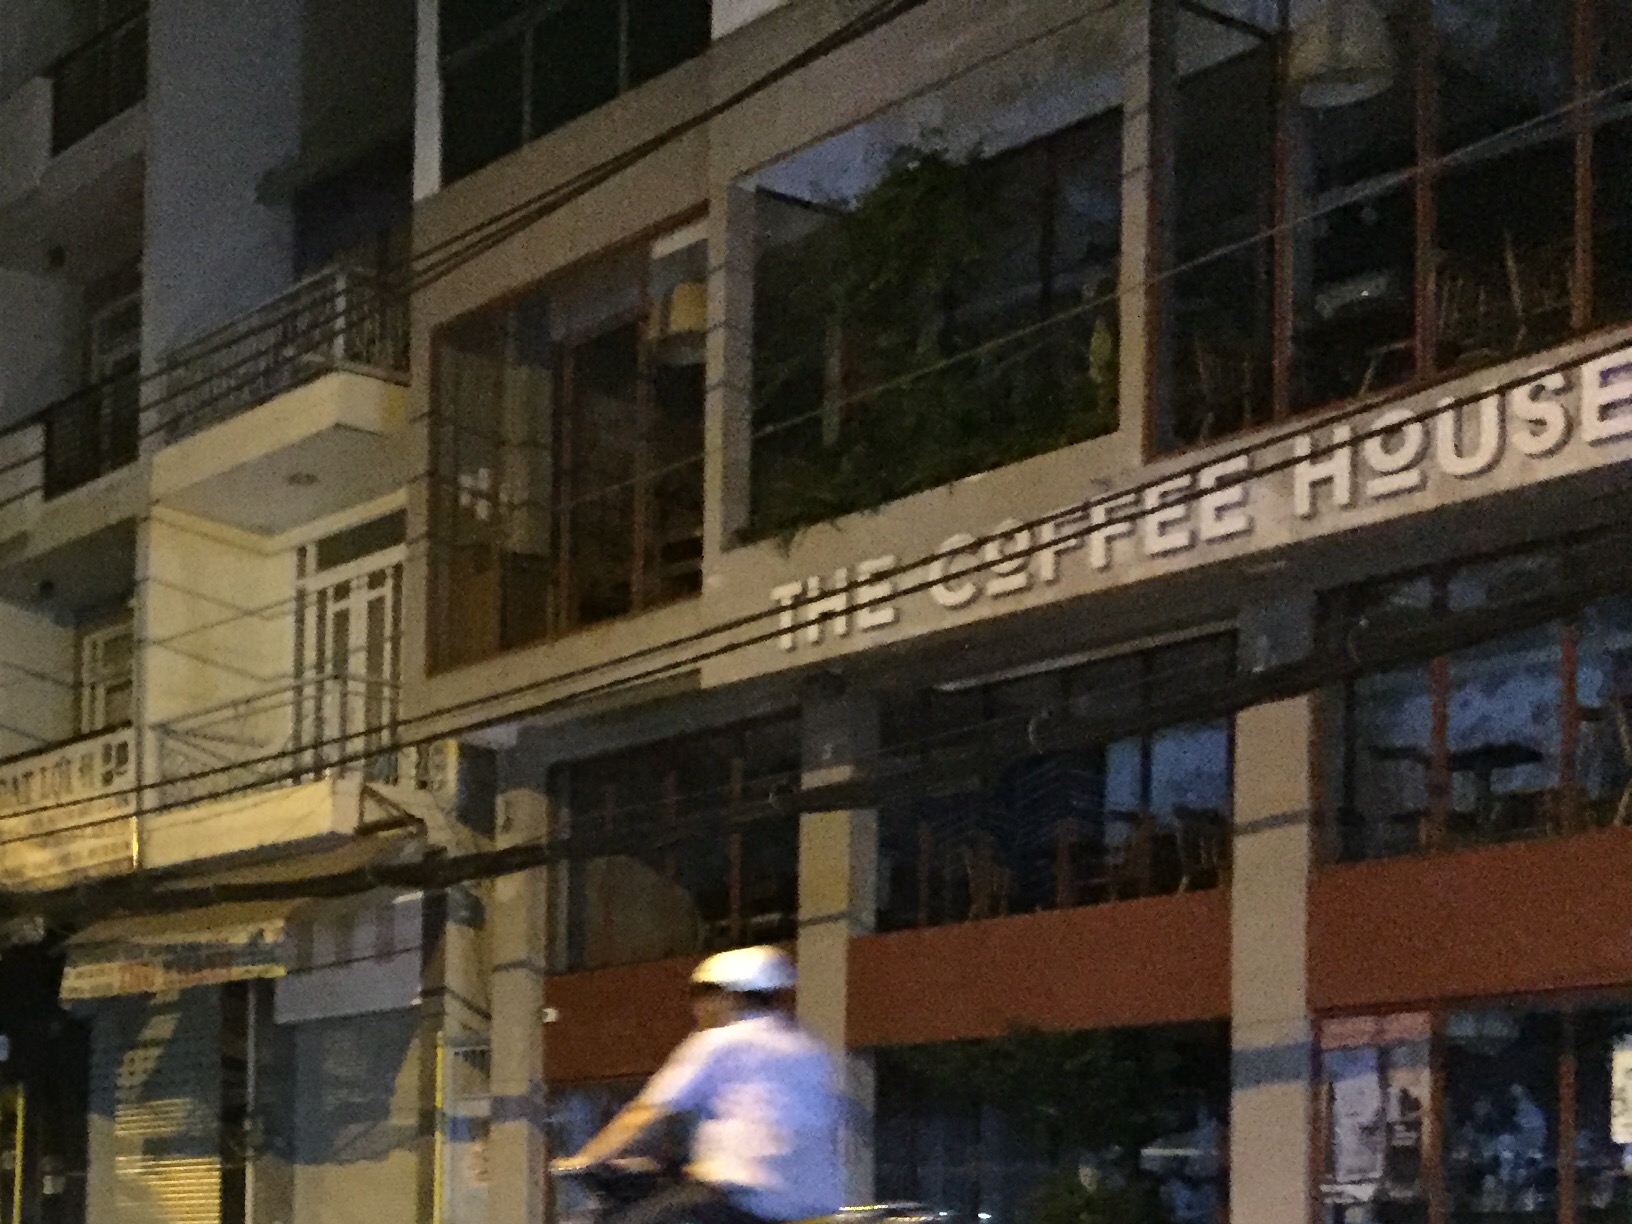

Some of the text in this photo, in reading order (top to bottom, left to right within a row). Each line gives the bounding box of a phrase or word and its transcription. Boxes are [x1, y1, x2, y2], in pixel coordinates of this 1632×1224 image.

[770, 348, 1632, 650] THE COFFEE HOUSE
